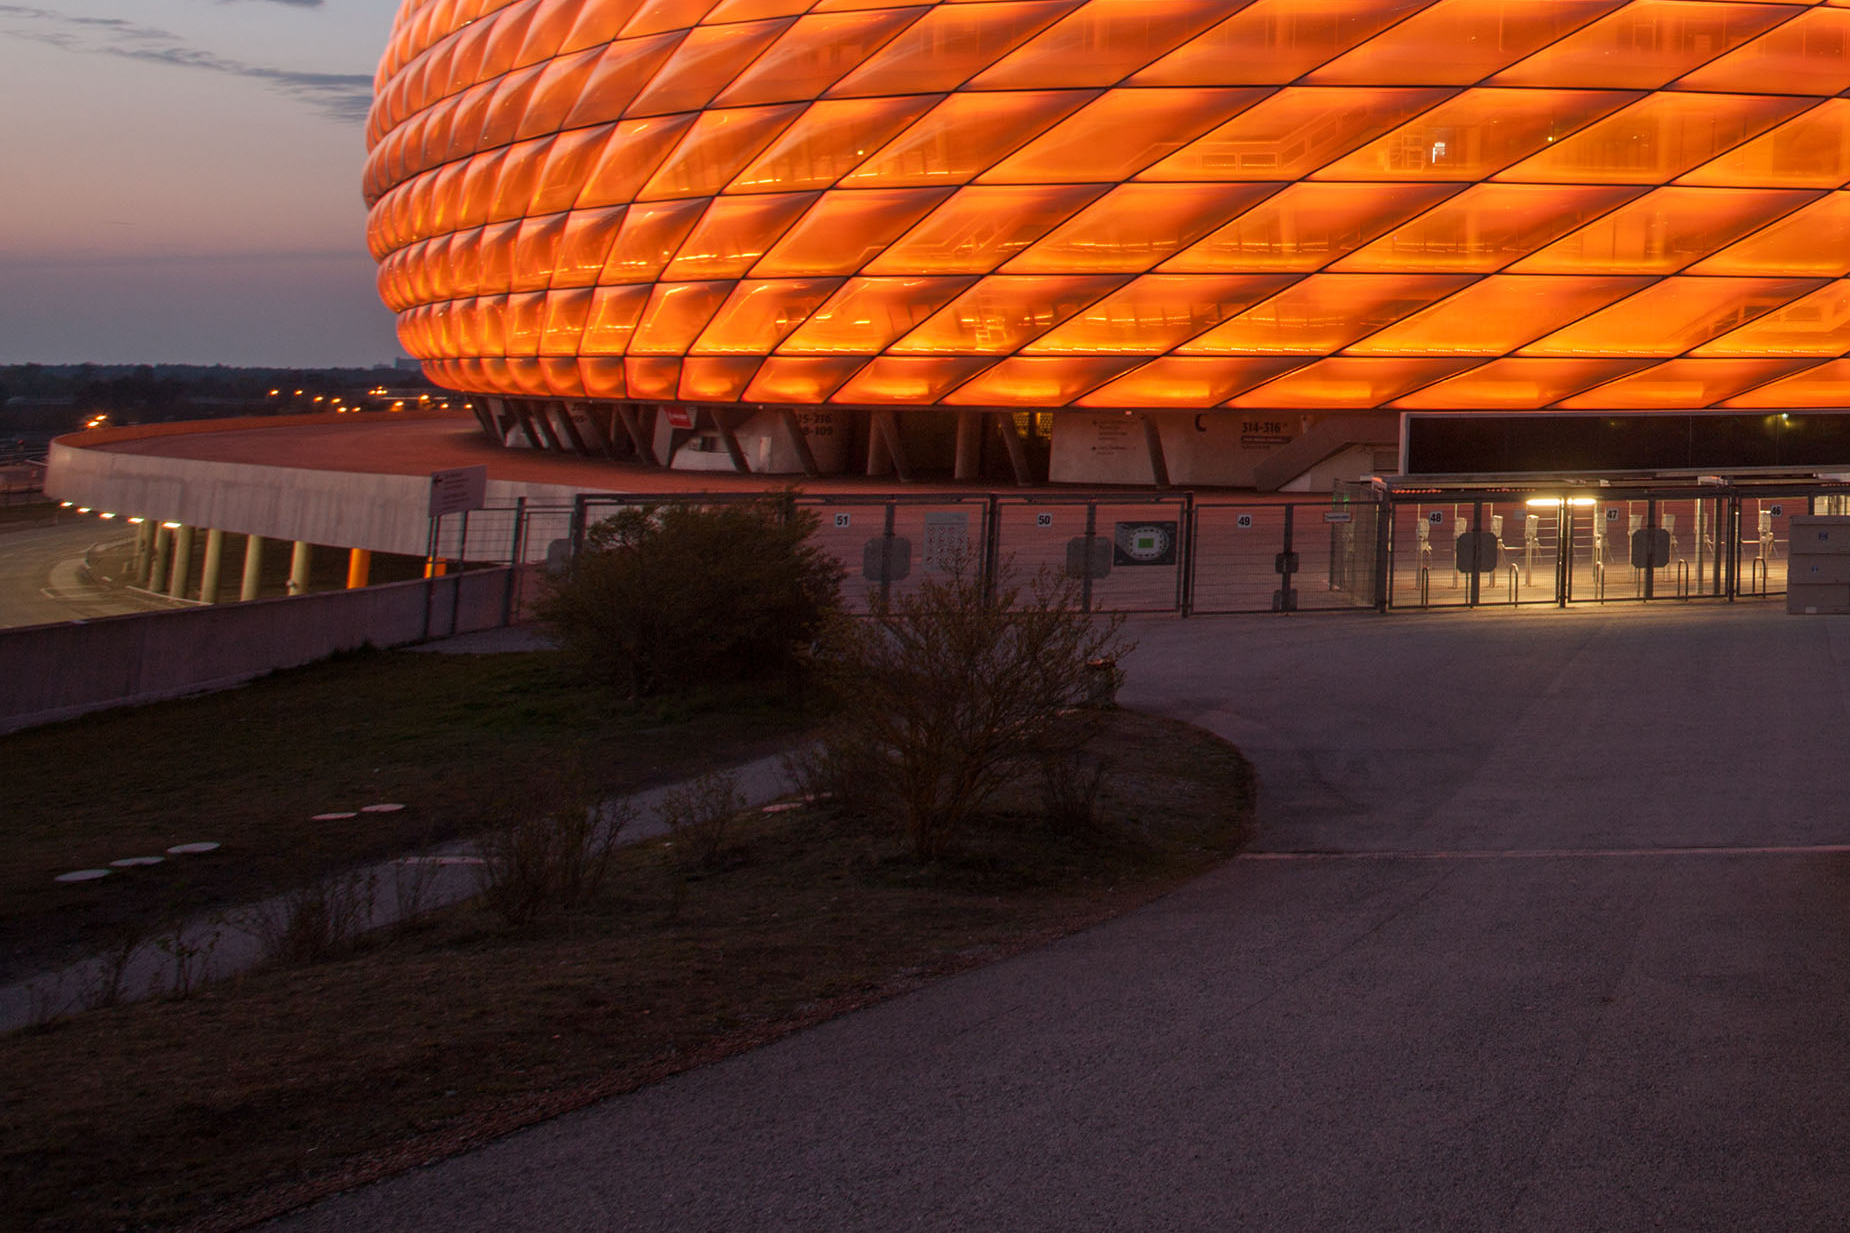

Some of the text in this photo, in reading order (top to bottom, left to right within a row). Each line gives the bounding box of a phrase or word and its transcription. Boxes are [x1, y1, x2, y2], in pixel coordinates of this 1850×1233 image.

[1430, 513, 1442, 522] 48
[1607, 510, 1618, 519] 47
[836, 516, 848, 526] 51
[1038, 515, 1050, 525] 50
[1239, 516, 1250, 526] 49
